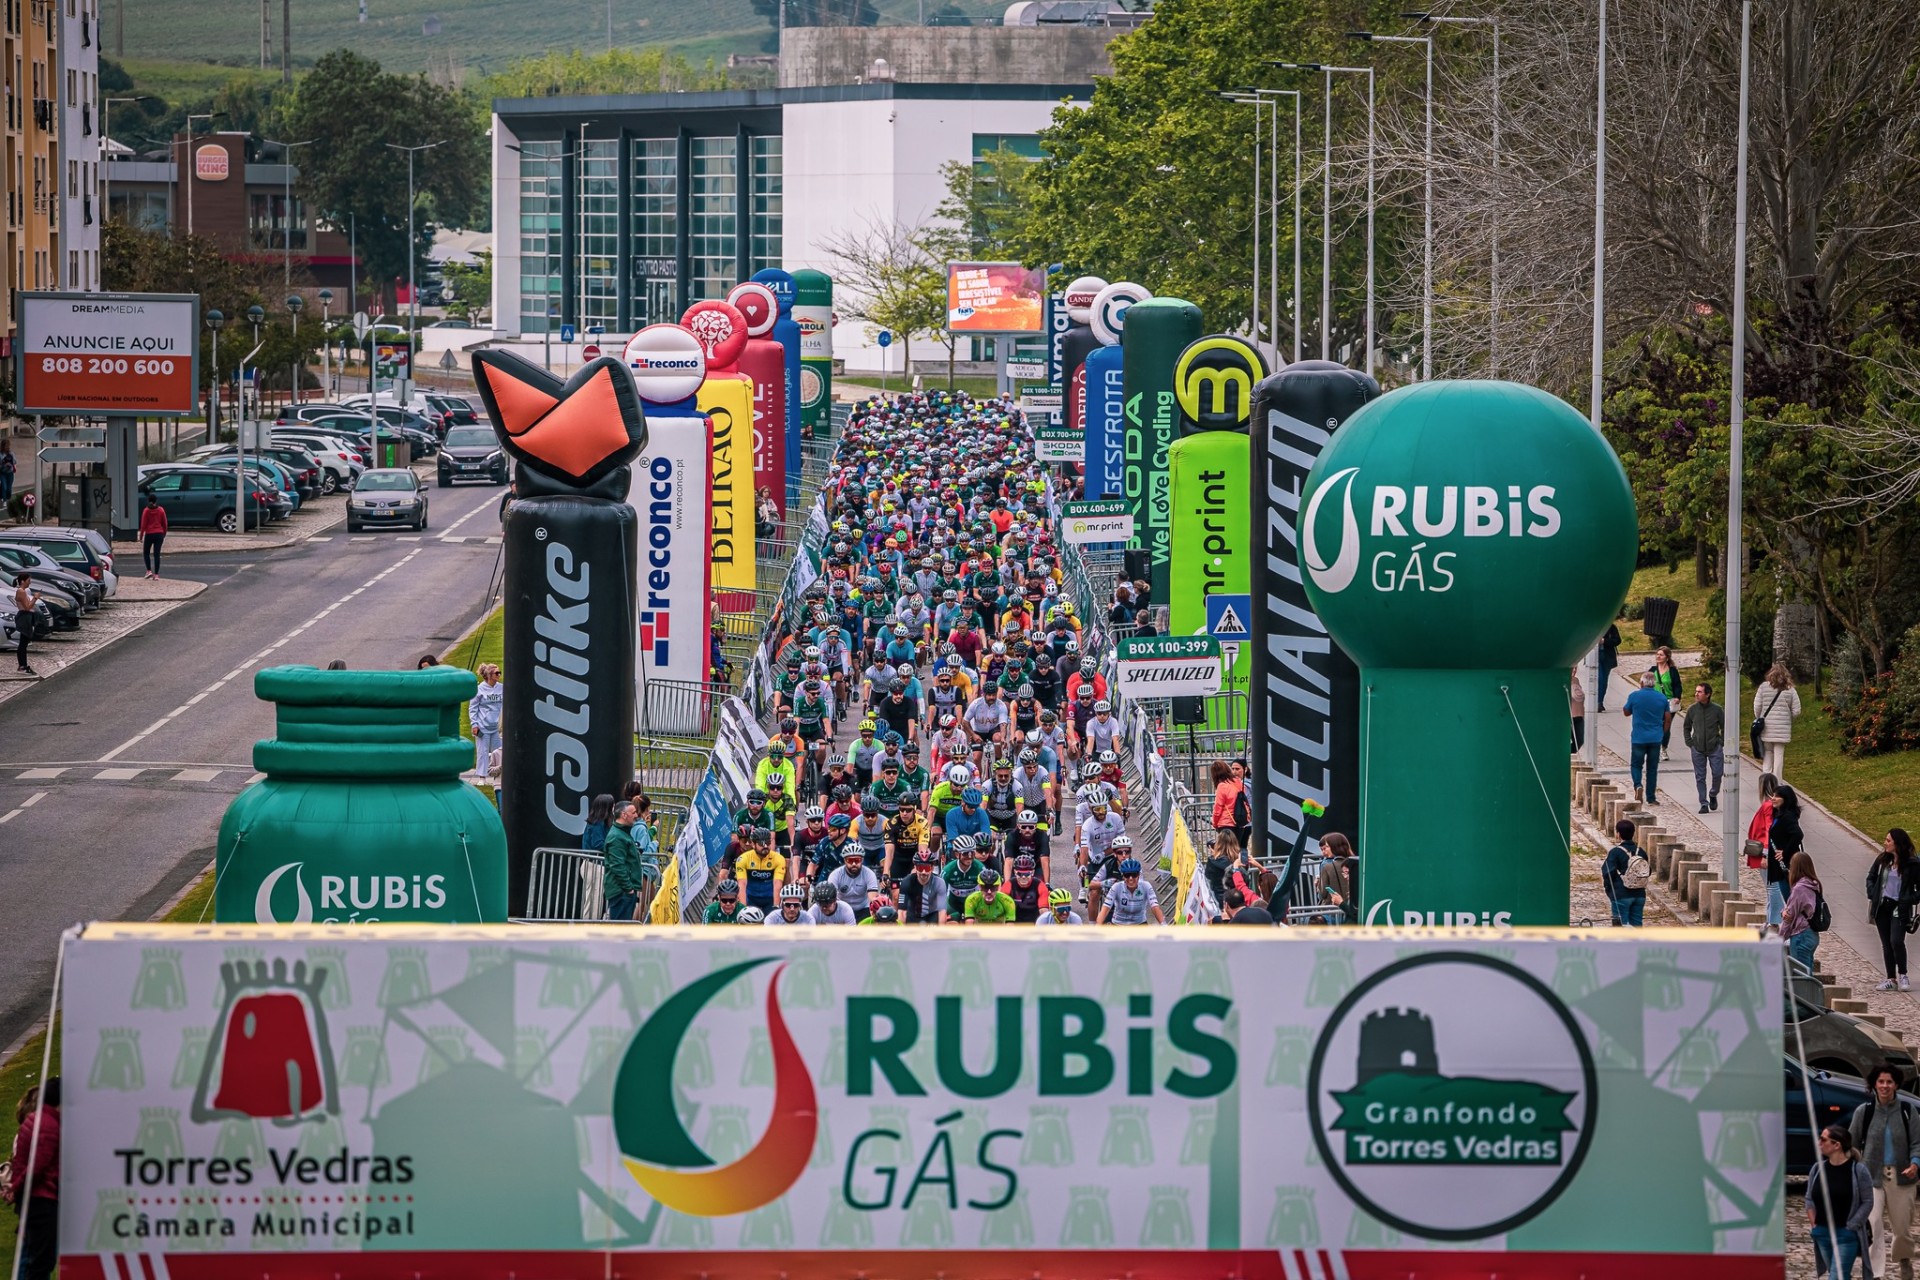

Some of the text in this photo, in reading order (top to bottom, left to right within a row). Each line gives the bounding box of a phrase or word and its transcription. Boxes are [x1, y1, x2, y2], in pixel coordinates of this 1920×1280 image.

[198, 156, 227, 164] BURGER
[198, 164, 227, 173] KING
[636, 260, 677, 276] CENTRO PASTO
[72, 305, 145, 314] DREAMMEDIA
[800, 322, 824, 331] AROLA
[43, 335, 174, 352] ANUNCIE AQUI
[1050, 290, 1069, 425] Plymark
[42, 357, 174, 375] 808 200 600
[649, 359, 698, 369] reconco
[1105, 369, 1124, 495] GESFROTA
[1152, 391, 1175, 469] Cycling
[676, 458, 684, 530] www.reconco.pt
[1070, 503, 1125, 513] BOX 400-699
[1370, 485, 1562, 538] RUBiS
[648, 457, 672, 608] reconco
[1152, 531, 1170, 566] We
[1371, 542, 1457, 592] GÁS
[1129, 641, 1208, 654] BOX 100-399
[1267, 409, 1332, 859] PECIALIZED
[534, 541, 590, 835] catlike
[1125, 666, 1215, 682] SPECIALIZED
[321, 874, 446, 910] RUBiS
[845, 993, 1238, 1099] RUBiS
[1365, 1101, 1536, 1124] Granfondo
[842, 1110, 1023, 1211] GÁS
[1353, 1135, 1557, 1159] Torres Vedras
[113, 1147, 415, 1185] Torres Vedras
[112, 1211, 415, 1240] Câmara Municipal
